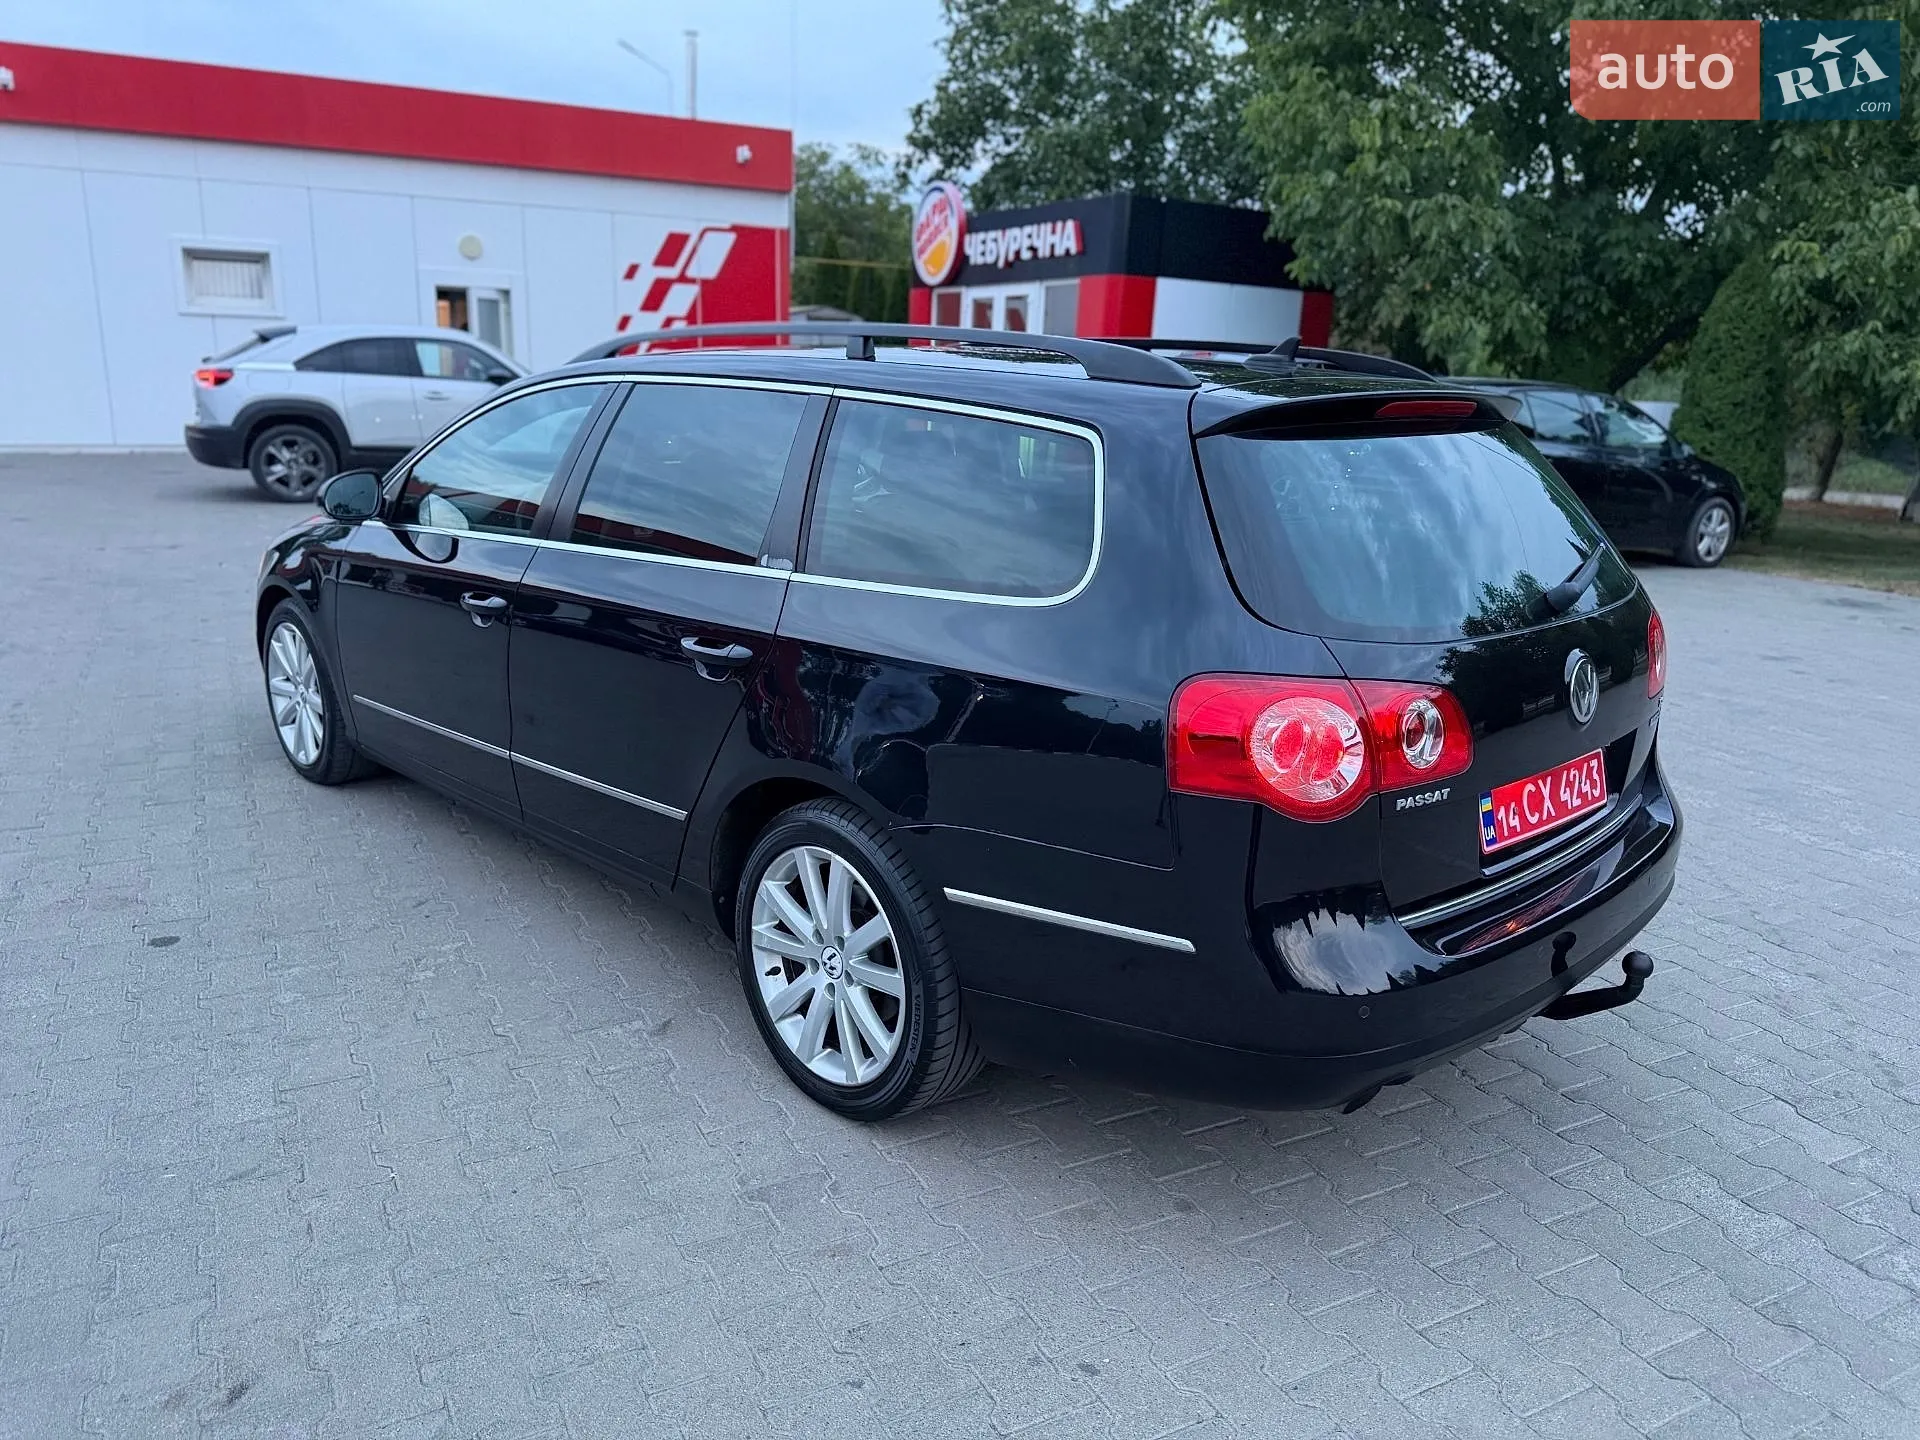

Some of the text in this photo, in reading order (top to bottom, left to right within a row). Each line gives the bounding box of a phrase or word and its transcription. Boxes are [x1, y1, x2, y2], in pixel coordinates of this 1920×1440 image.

[964, 218, 1079, 269] ЧЕБУРЕЧНА
[1396, 787, 1451, 811] PASSAT
[1497, 758, 1601, 837] 14 CX 4243
[1484, 824, 1496, 841] UA
